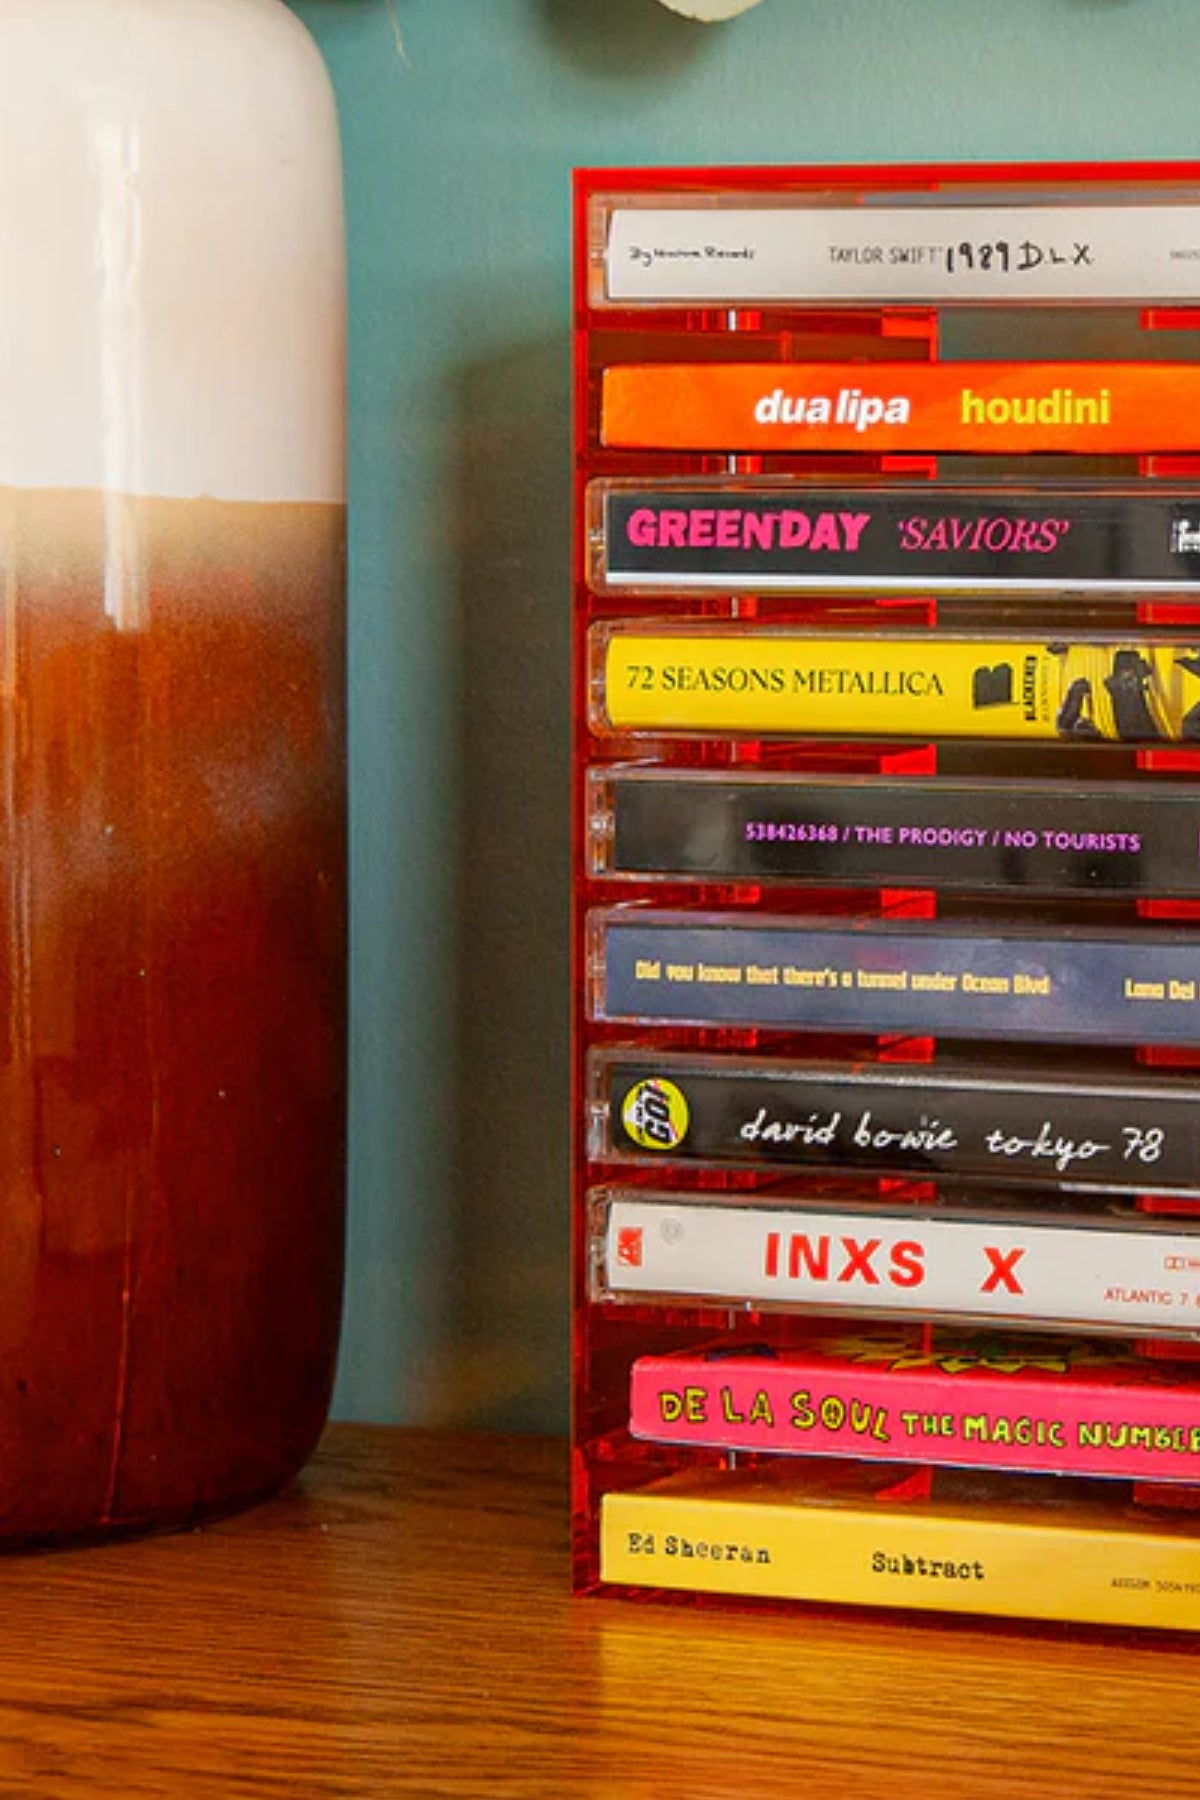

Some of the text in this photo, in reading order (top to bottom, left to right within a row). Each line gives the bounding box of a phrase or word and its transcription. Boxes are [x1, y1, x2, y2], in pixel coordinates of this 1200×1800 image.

[828, 246, 883, 264] TAYLOR
[947, 242, 1009, 273] 1989
[755, 390, 911, 432] dua lipa
[961, 389, 1110, 424] houdini
[626, 665, 945, 697] 72 SEASONS METALLICA
[843, 823, 850, 843] /
[855, 826, 893, 845] THE
[899, 827, 988, 848] PRODIGY
[990, 828, 999, 847] /
[1004, 830, 1037, 849] NO
[1043, 831, 1142, 853] TOURISTS
[634, 960, 1050, 995] Did you know that there's a tunnel under Ocean Blvd
[1124, 977, 1165, 999] Lana
[1168, 980, 1195, 1000] Del
[740, 1108, 1165, 1172] david bowie tokyo 78
[764, 1231, 1026, 1294] INXS X
[1104, 1286, 1172, 1305] ATLANTIC
[659, 1387, 706, 1422] DE
[721, 1387, 773, 1427] LA
[791, 1391, 891, 1442] SOUL
[901, 1412, 954, 1436] THE
[962, 1413, 1065, 1448] MAGIC
[628, 1532, 771, 1564] Ed Sheeran
[872, 1551, 986, 1581] Subtract
